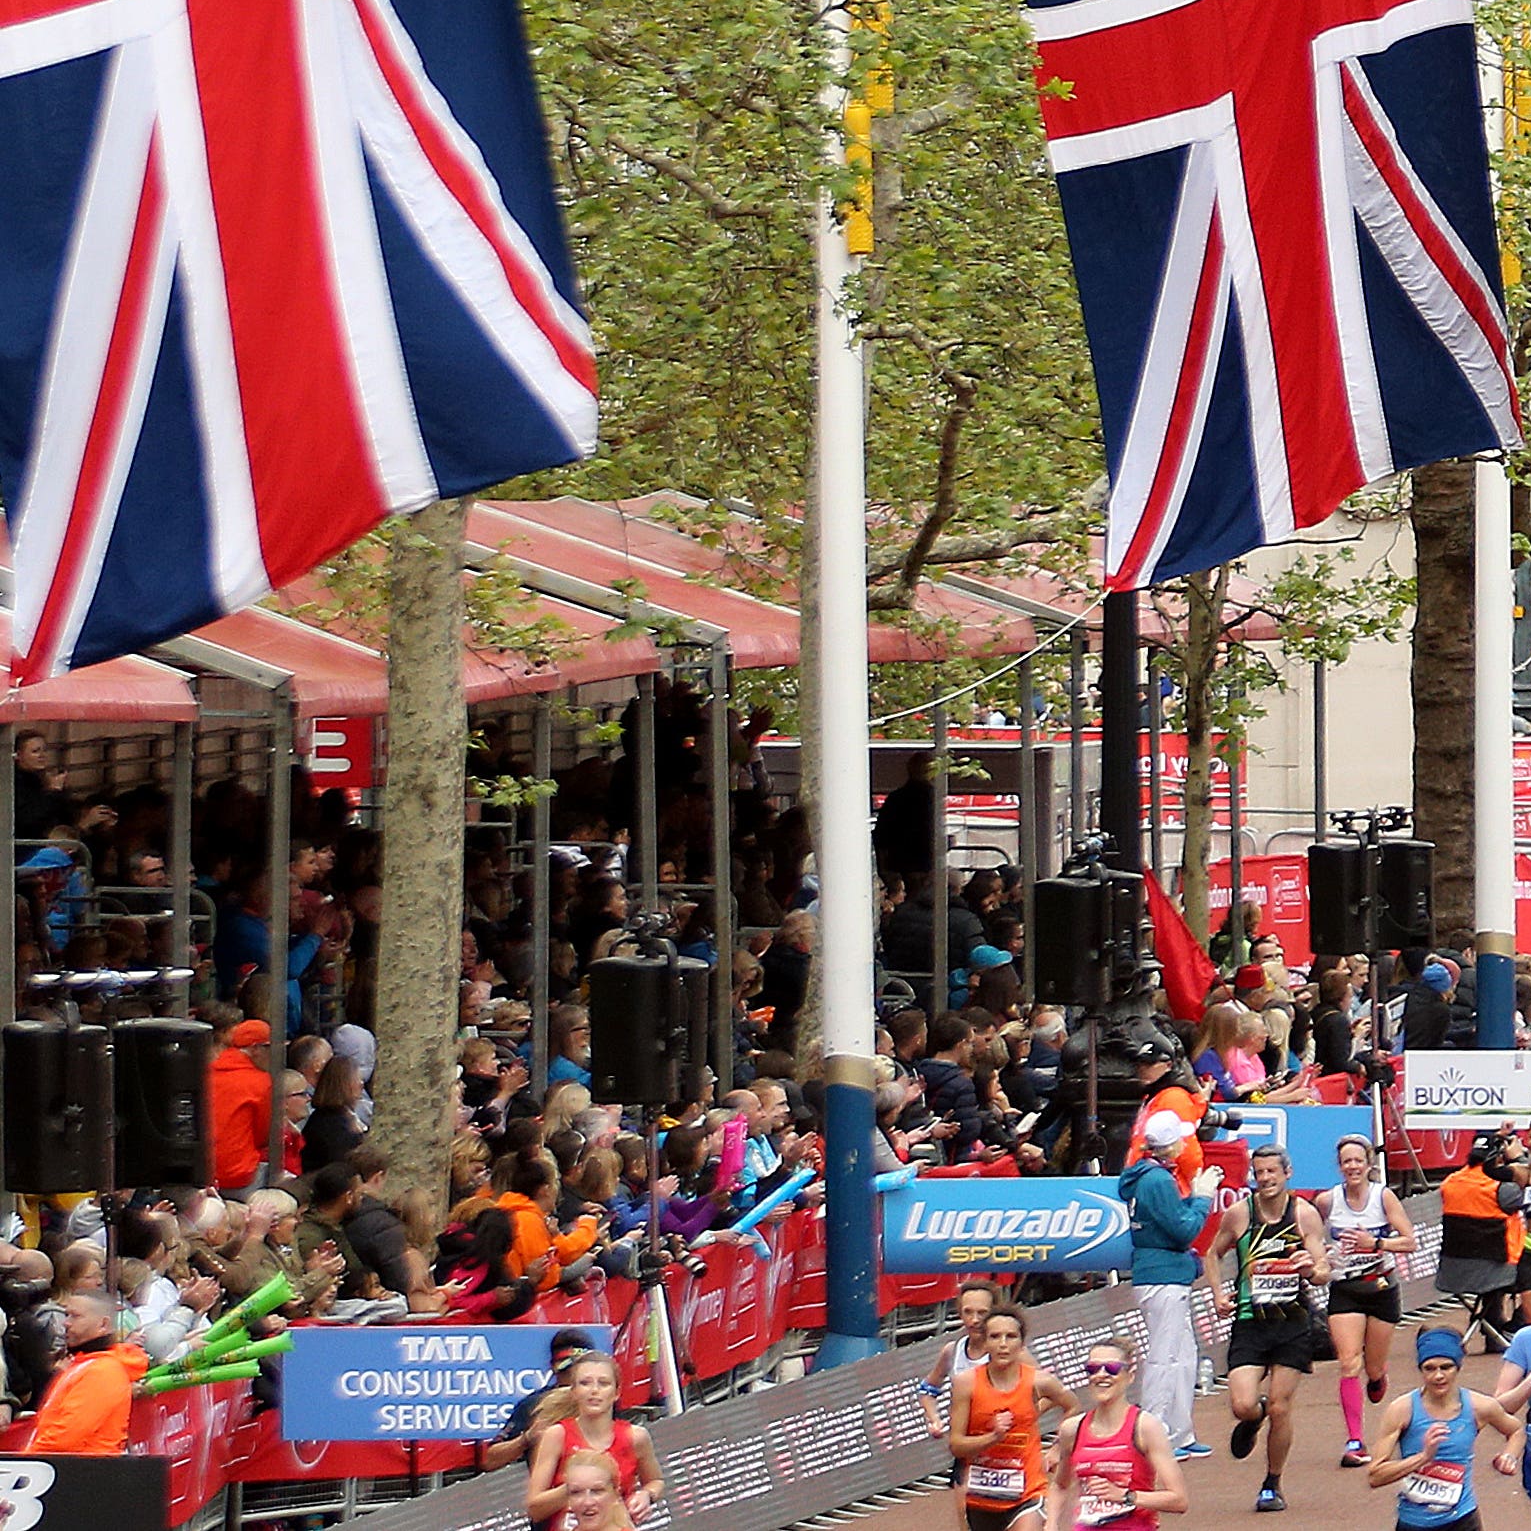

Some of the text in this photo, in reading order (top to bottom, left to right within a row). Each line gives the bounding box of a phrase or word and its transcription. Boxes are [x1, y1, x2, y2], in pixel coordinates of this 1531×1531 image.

[1413, 1086, 1505, 1107] BUXTON
[903, 1201, 1104, 1241] Lucozade
[947, 1244, 1056, 1264] SPORT
[401, 1335, 494, 1362] TATA
[340, 1369, 553, 1398] CONSULTANCY
